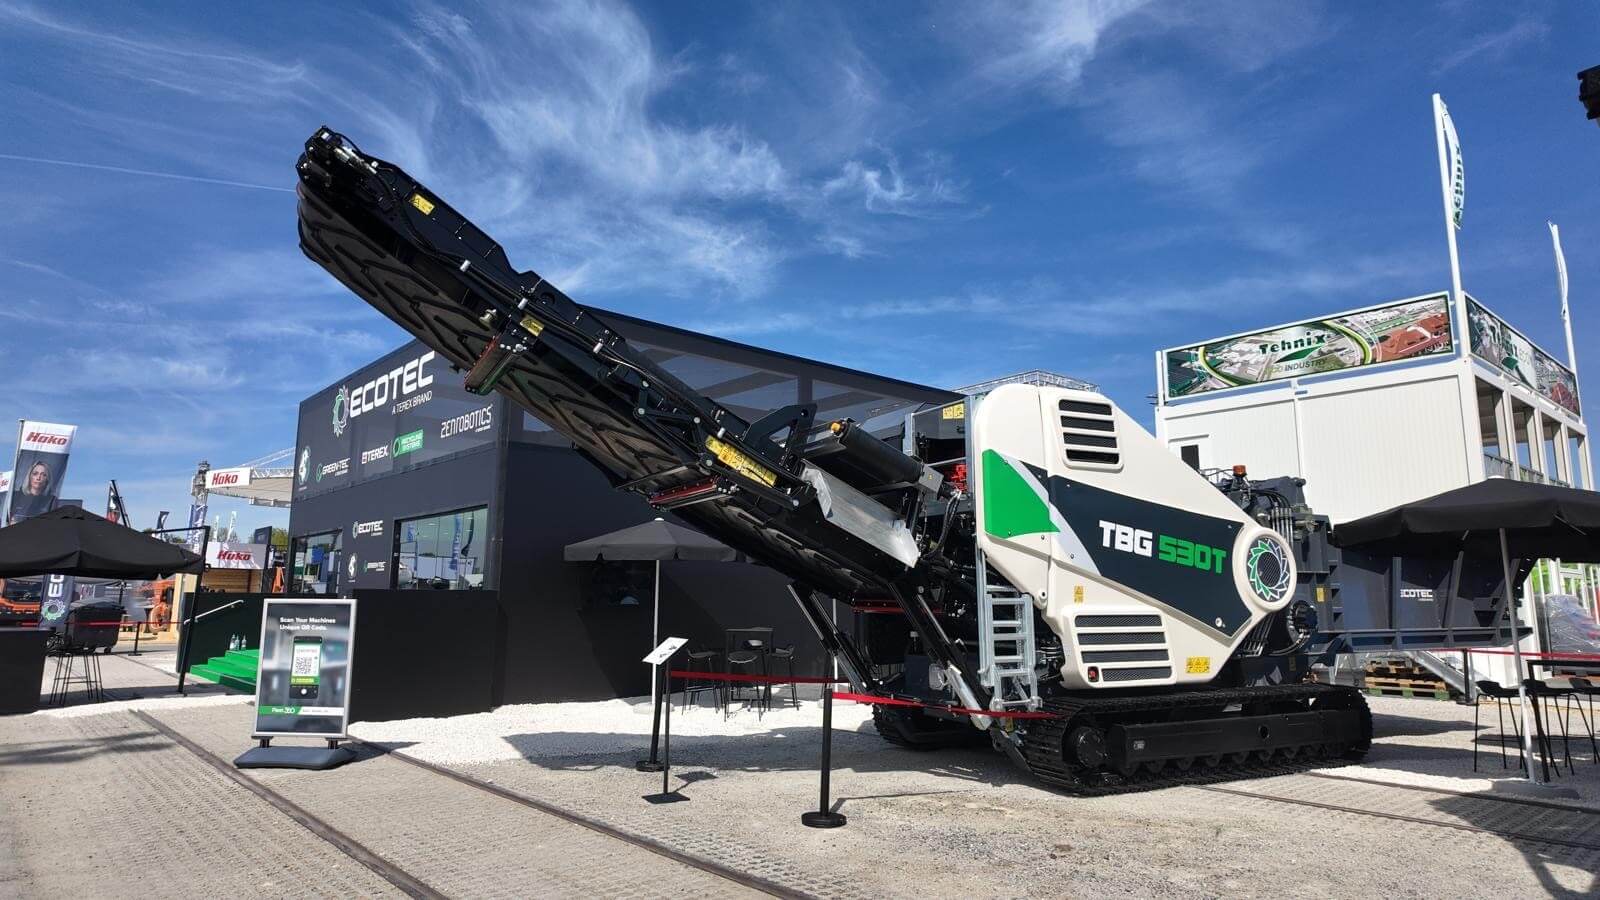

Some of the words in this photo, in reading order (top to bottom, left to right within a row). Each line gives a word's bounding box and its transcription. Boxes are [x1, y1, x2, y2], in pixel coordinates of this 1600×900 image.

[1259, 331, 1326, 355] Tehnix
[1284, 359, 1328, 372] INDUSTRY
[349, 350, 436, 418] ECOTEC
[26, 431, 68, 446] Hako
[367, 445, 389, 461] TEREX
[211, 471, 239, 486] Hako
[358, 520, 383, 533] ECOTEC
[1099, 519, 1153, 558] TBG
[1158, 534, 1227, 574] 530T
[216, 550, 251, 561] Hako
